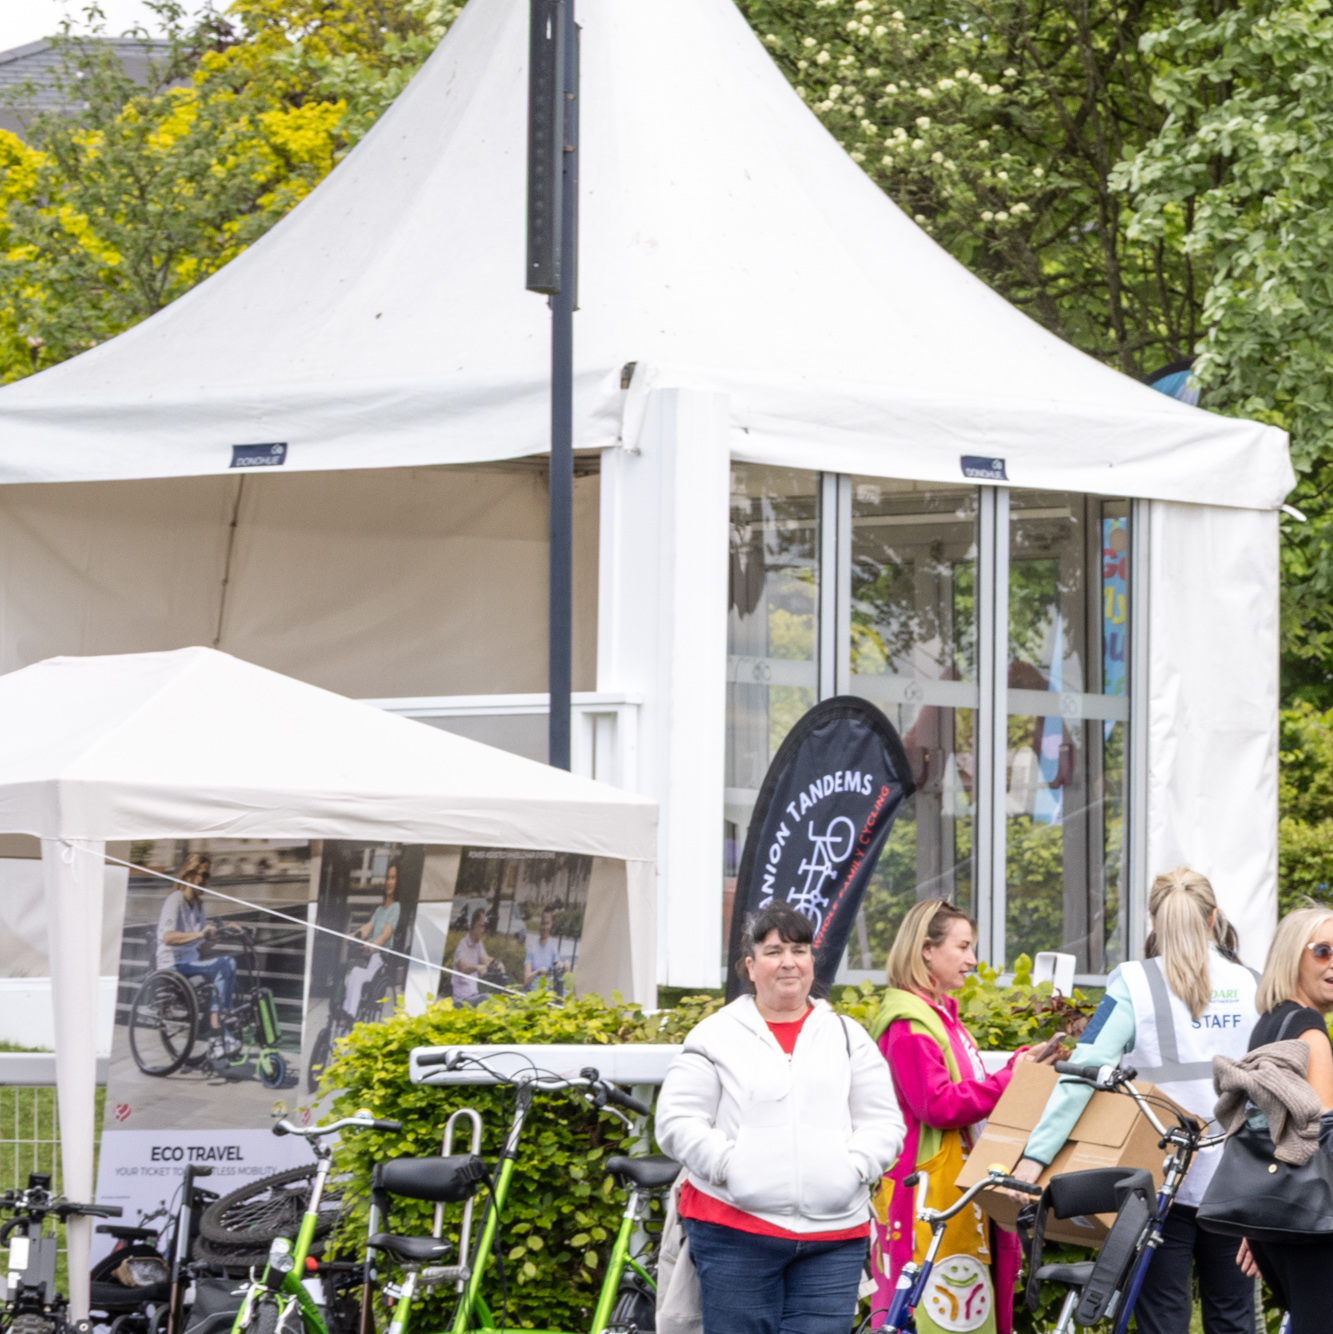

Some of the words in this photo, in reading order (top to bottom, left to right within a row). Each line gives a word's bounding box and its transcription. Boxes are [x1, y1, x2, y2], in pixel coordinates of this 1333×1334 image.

[786, 770, 873, 822] TANDEMS
[858, 785, 890, 846] CYCLING
[1192, 1014, 1241, 1029] STAFF
[151, 1146, 184, 1161] ECO
[187, 1146, 243, 1161] TRAVEL
[115, 1167, 138, 1176] YOUR
[238, 1165, 277, 1176] MOBILITY
